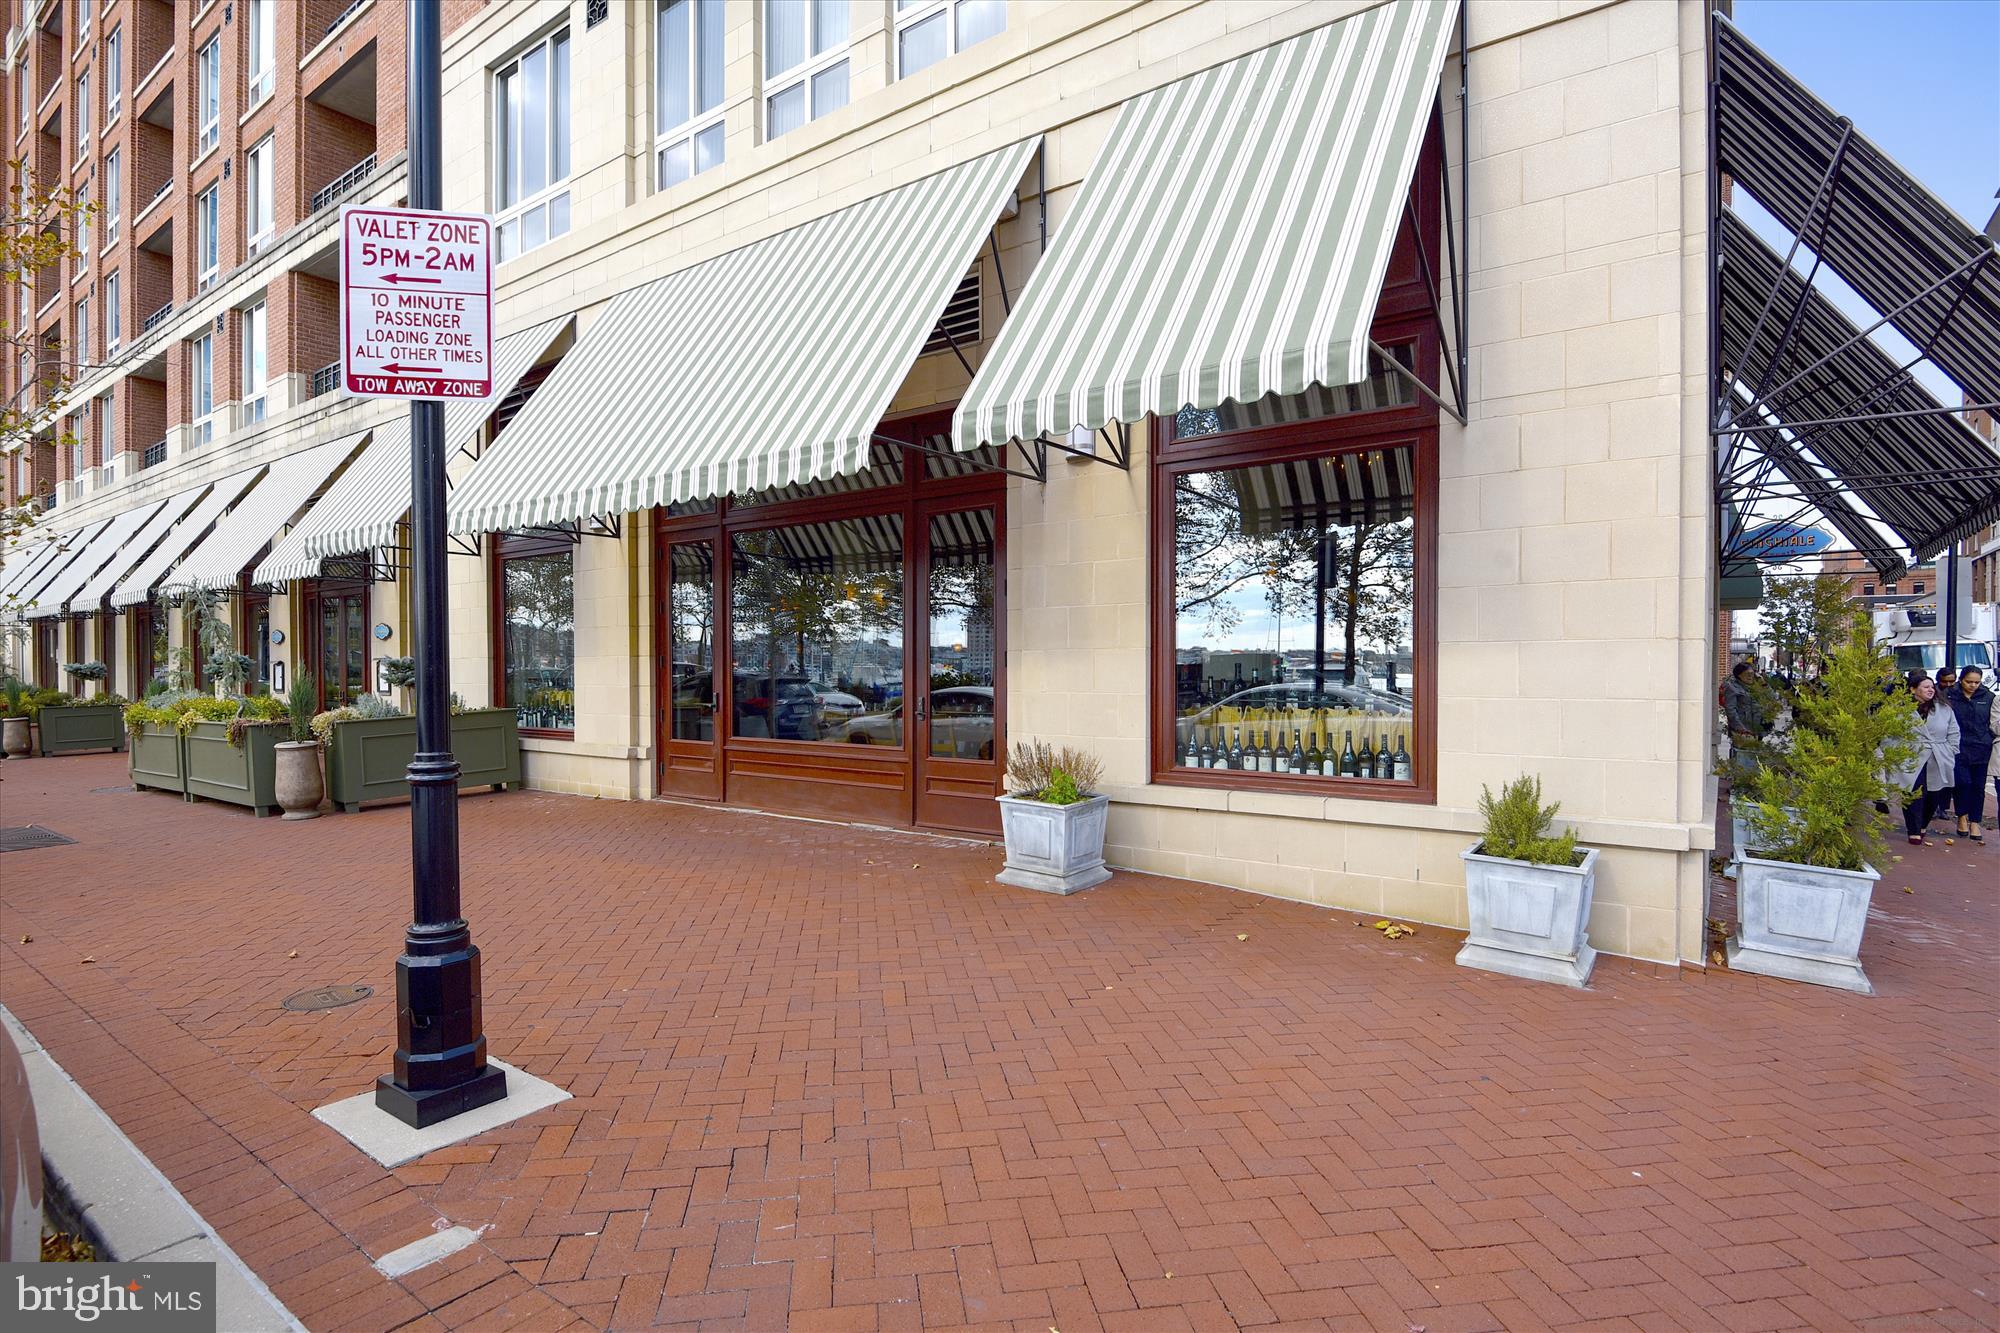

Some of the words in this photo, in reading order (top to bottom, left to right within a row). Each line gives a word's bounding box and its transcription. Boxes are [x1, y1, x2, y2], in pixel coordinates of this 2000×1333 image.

[356, 217, 420, 241] VALET
[427, 222, 480, 244] ZONE
[362, 243, 475, 272] 5PM-2AM
[371, 293, 389, 307] 10
[398, 294, 465, 311] MINUTE
[375, 310, 461, 329] PASSENGER
[366, 329, 429, 345] LOADING
[435, 332, 472, 347] ZONE
[355, 345, 385, 359] ALL
[390, 346, 437, 361] OTHER
[442, 349, 483, 364] TIMES
[356, 377, 388, 392] TOW
[394, 379, 437, 394] AWAY
[443, 381, 483, 396] ZONE
